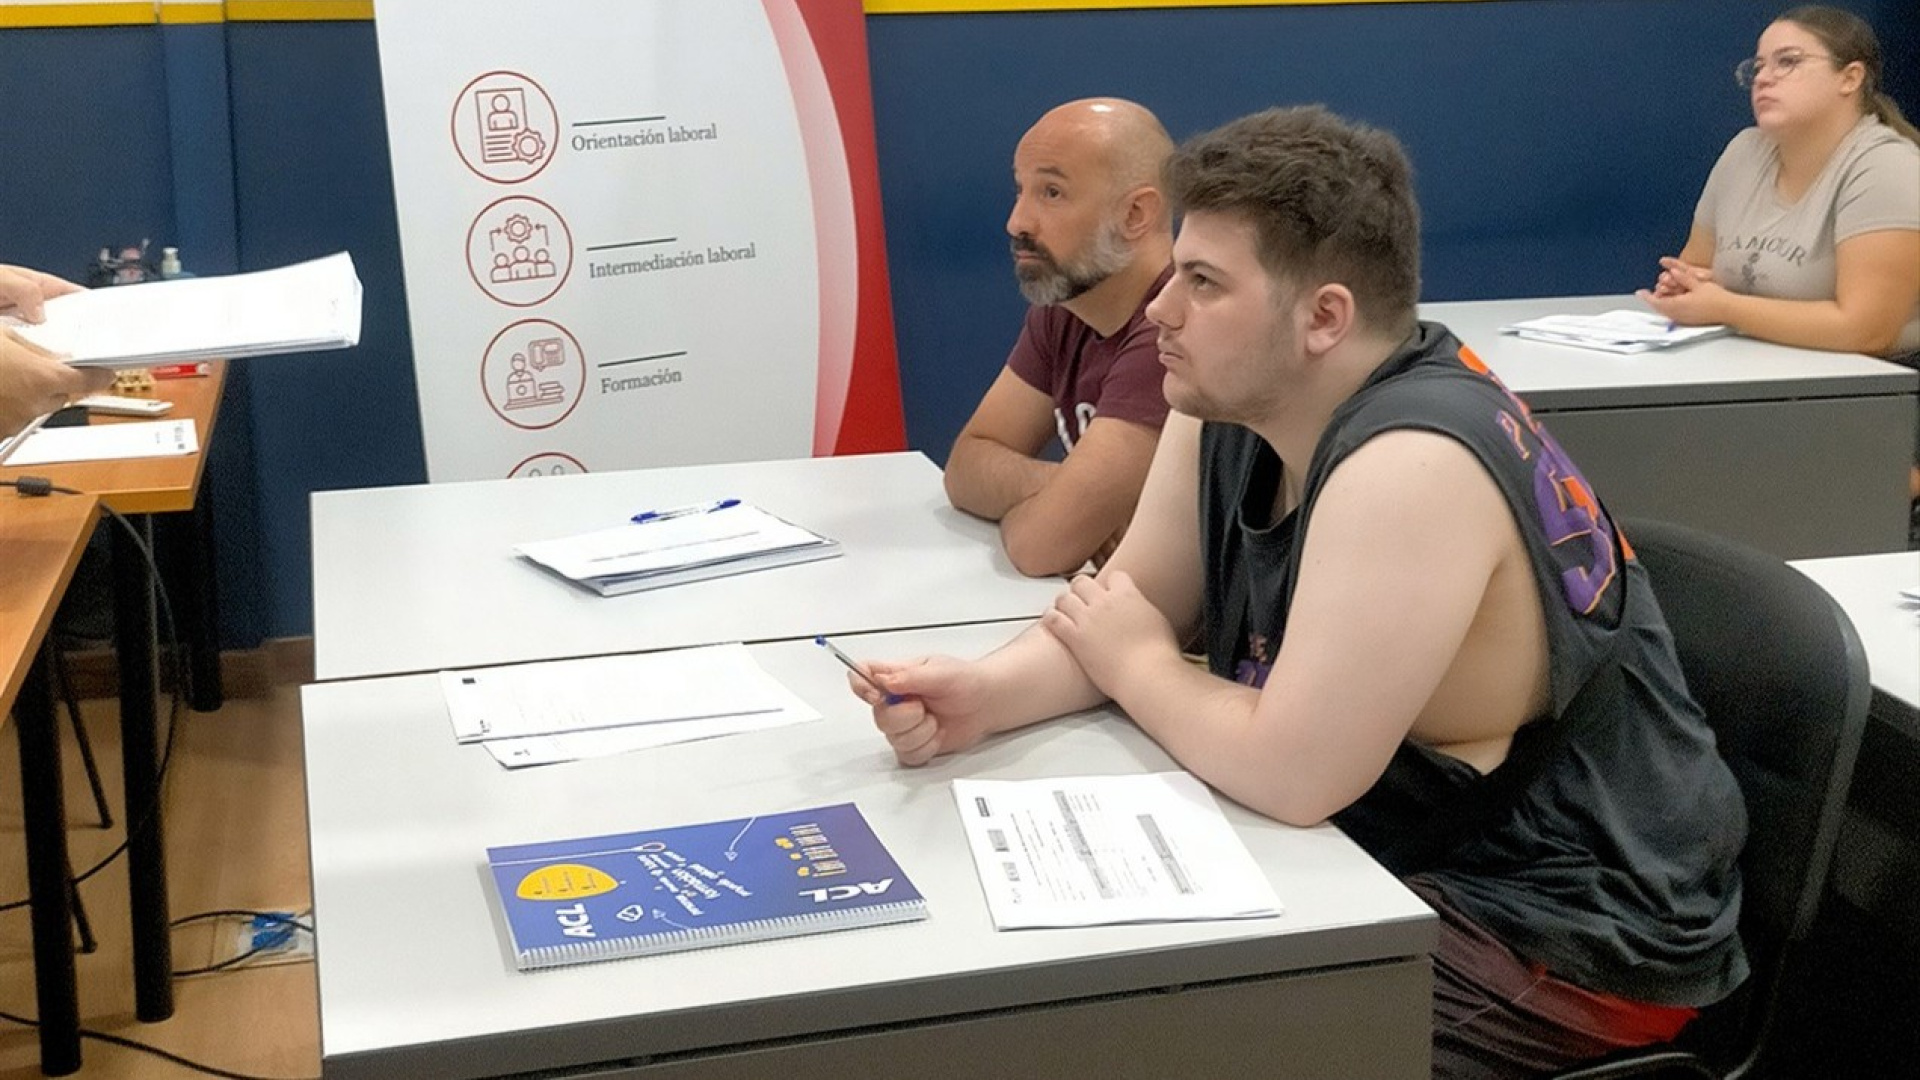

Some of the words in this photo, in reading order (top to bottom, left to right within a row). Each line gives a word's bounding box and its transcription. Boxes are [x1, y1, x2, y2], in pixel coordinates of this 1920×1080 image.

[571, 129, 665, 151] Orientación
[668, 123, 718, 143] laboral
[589, 250, 705, 279] Intermediación
[707, 242, 757, 264] laboral
[600, 368, 682, 394] Formación
[798, 878, 894, 903] ACL
[555, 902, 597, 938] ACL
